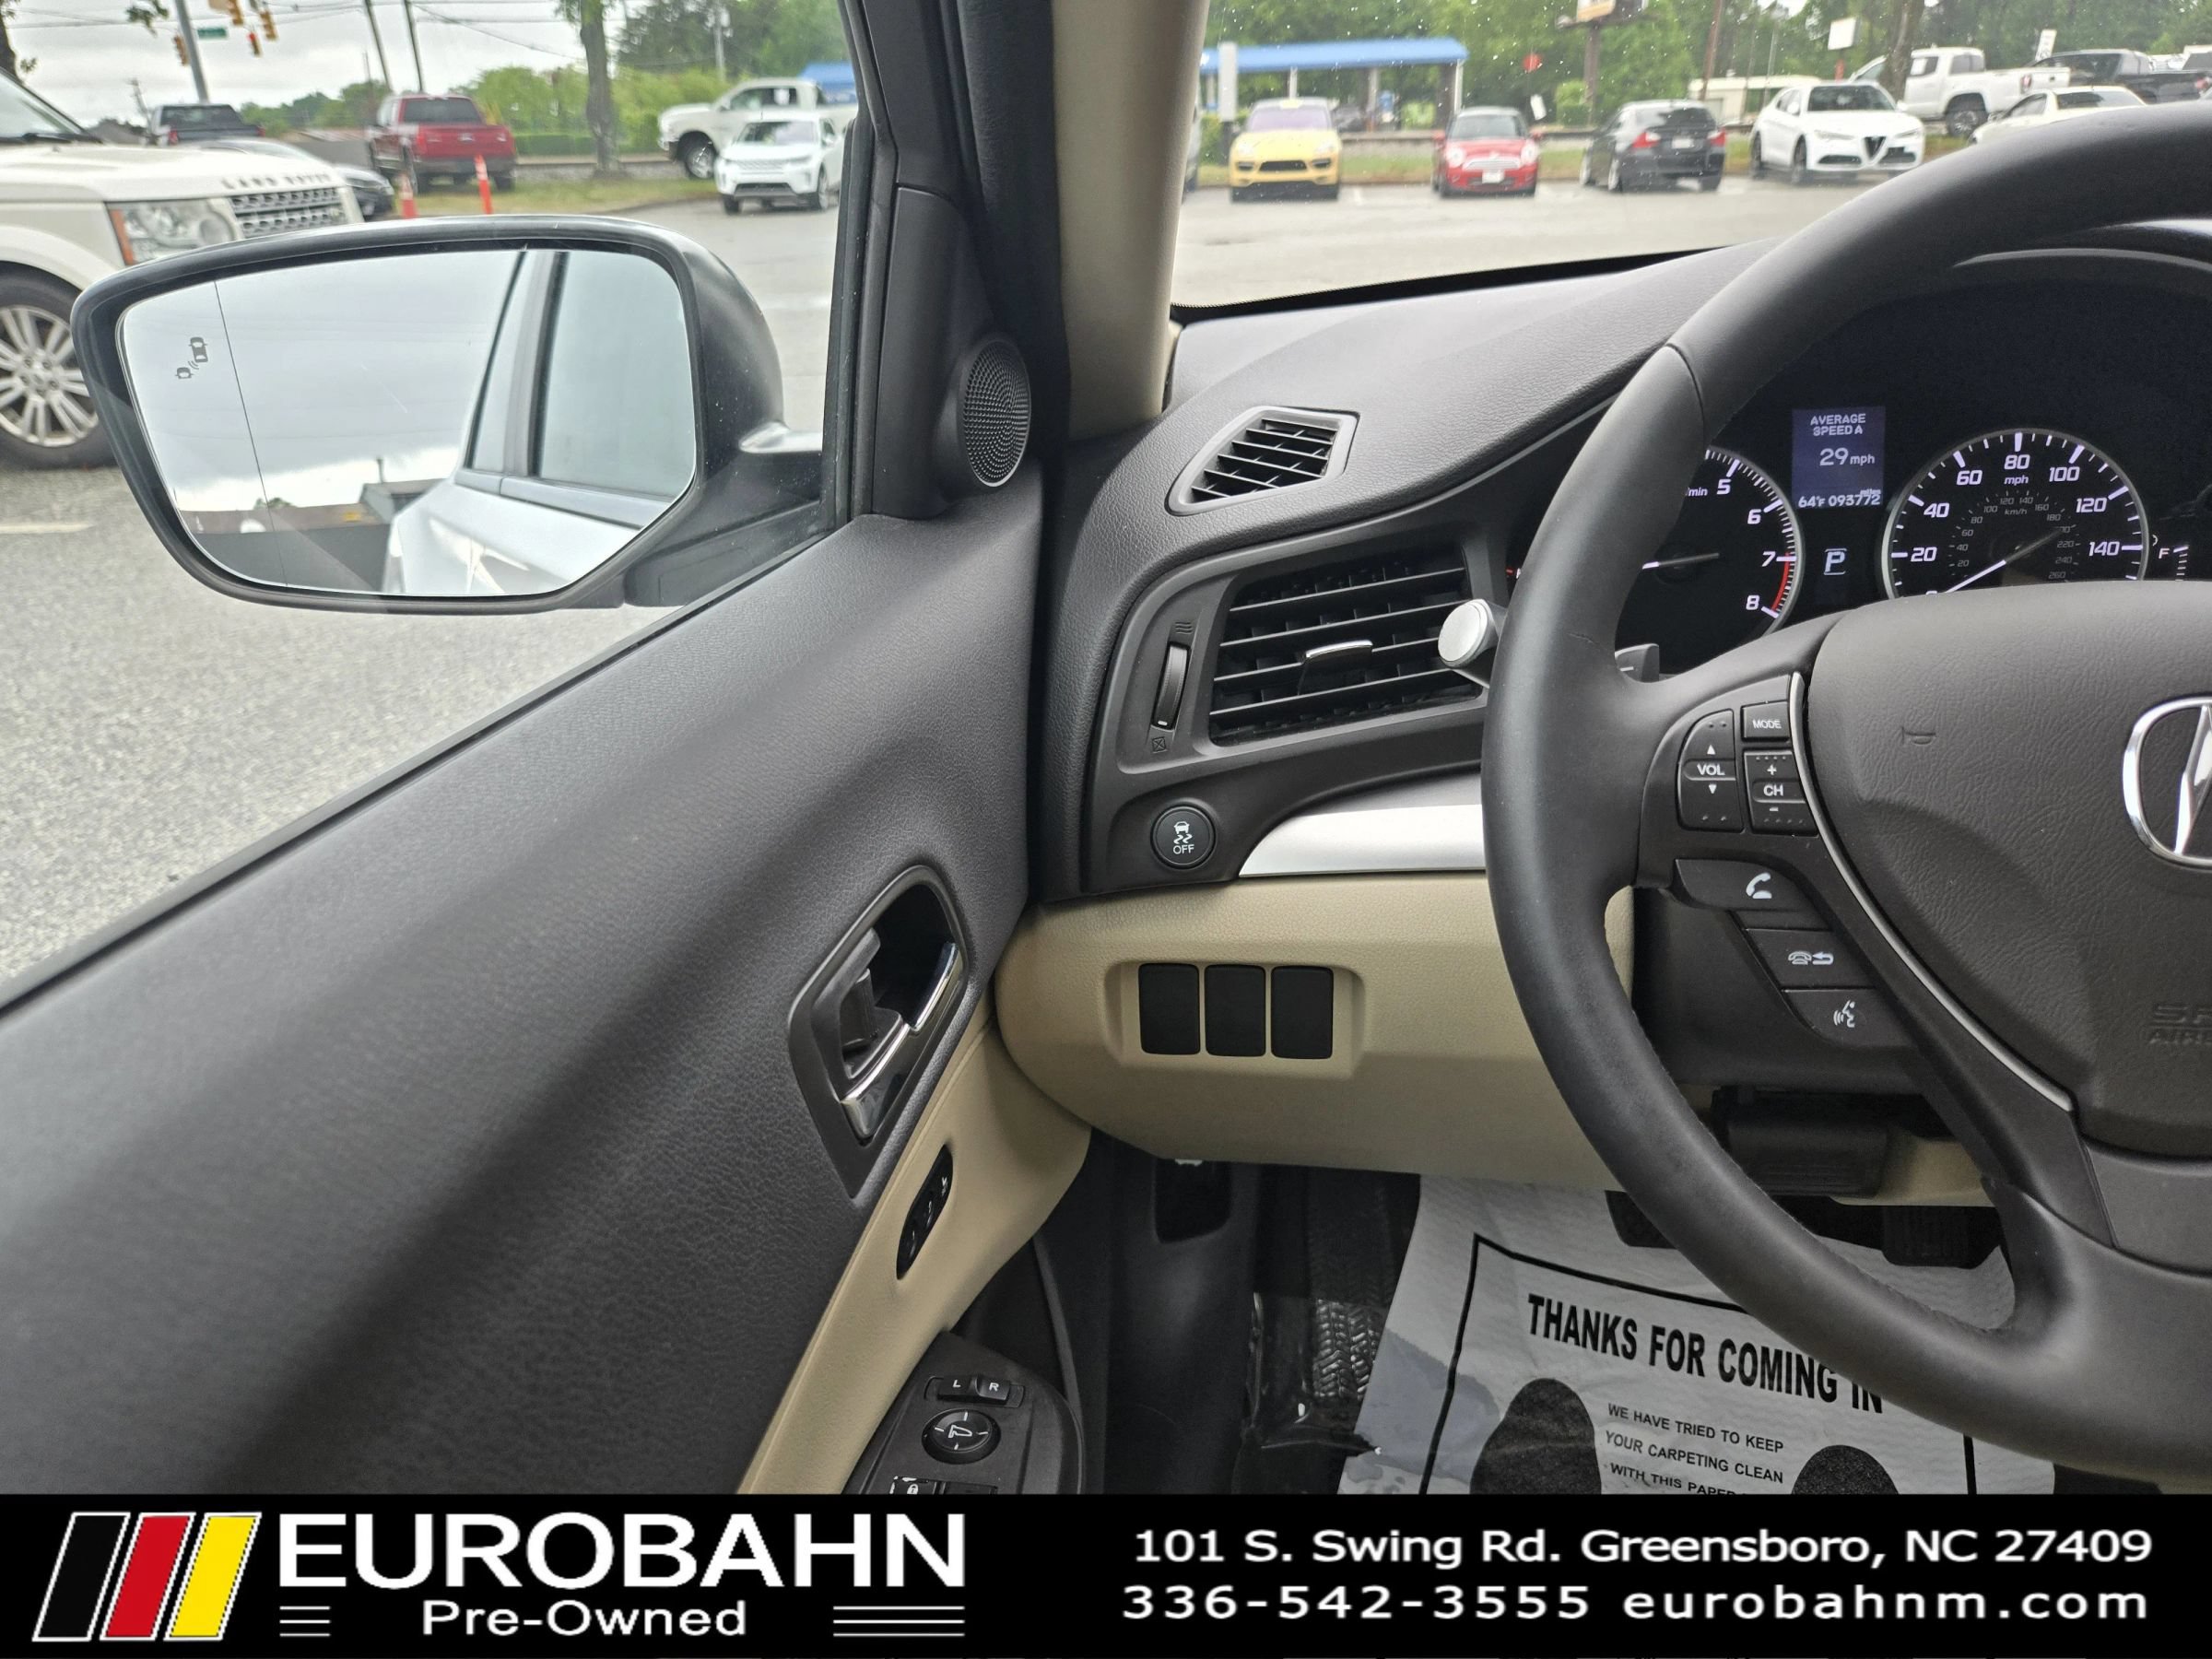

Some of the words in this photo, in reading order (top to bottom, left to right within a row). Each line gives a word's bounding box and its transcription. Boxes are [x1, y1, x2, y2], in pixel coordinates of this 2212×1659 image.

[1810, 413, 1866, 426] AVERAGE
[1813, 424, 1853, 436] SPEED
[1854, 424, 1863, 435] A
[1819, 447, 1849, 466] 29
[1850, 453, 1876, 466] mph
[2004, 454, 2030, 469] 80
[1956, 469, 1983, 486] 60
[2004, 474, 2030, 486] mph
[2049, 465, 2080, 482] 100
[1716, 478, 1732, 495] 5
[1828, 494, 1881, 506] 093772
[1999, 497, 2015, 505] 120
[2076, 497, 2108, 513] 120
[1924, 502, 1949, 518] 40
[1983, 505, 1998, 513] 100
[2034, 503, 2050, 512] 160
[1747, 509, 1762, 524] 6
[1971, 516, 1983, 524] 80
[2046, 513, 2062, 522] 180
[2056, 540, 2075, 548] 220
[2088, 541, 2121, 557] 140
[1761, 551, 1777, 567] 7
[1910, 547, 1937, 562] 20
[2159, 547, 2171, 559] F
[1825, 550, 1846, 573] P
[2054, 556, 2073, 564] 240
[2048, 571, 2066, 579] 260
[1746, 595, 1760, 610] 8
[1752, 719, 1782, 729] MODE
[1697, 763, 1725, 776] VOL
[1763, 784, 1784, 797] CH
[1172, 844, 1194, 854] OFF
[1527, 1293, 1638, 1360] THANKS
[1648, 1324, 1705, 1378] FOR
[1718, 1337, 1838, 1403] COMING
[952, 1379, 961, 1388] L
[988, 1382, 1000, 1392] R
[1607, 1403, 1630, 1419] WE
[1633, 1410, 1670, 1430] HAVE
[1675, 1420, 1716, 1439] TRIED
[1721, 1429, 1740, 1444] TO
[1746, 1434, 1784, 1453] KEEP
[1606, 1430, 1643, 1453] YOUR
[1648, 1443, 1729, 1472] CARPETING
[1734, 1463, 1784, 1484] CLEAN
[1610, 1462, 1646, 1482] WITH
[1650, 1473, 1682, 1488] THIS
